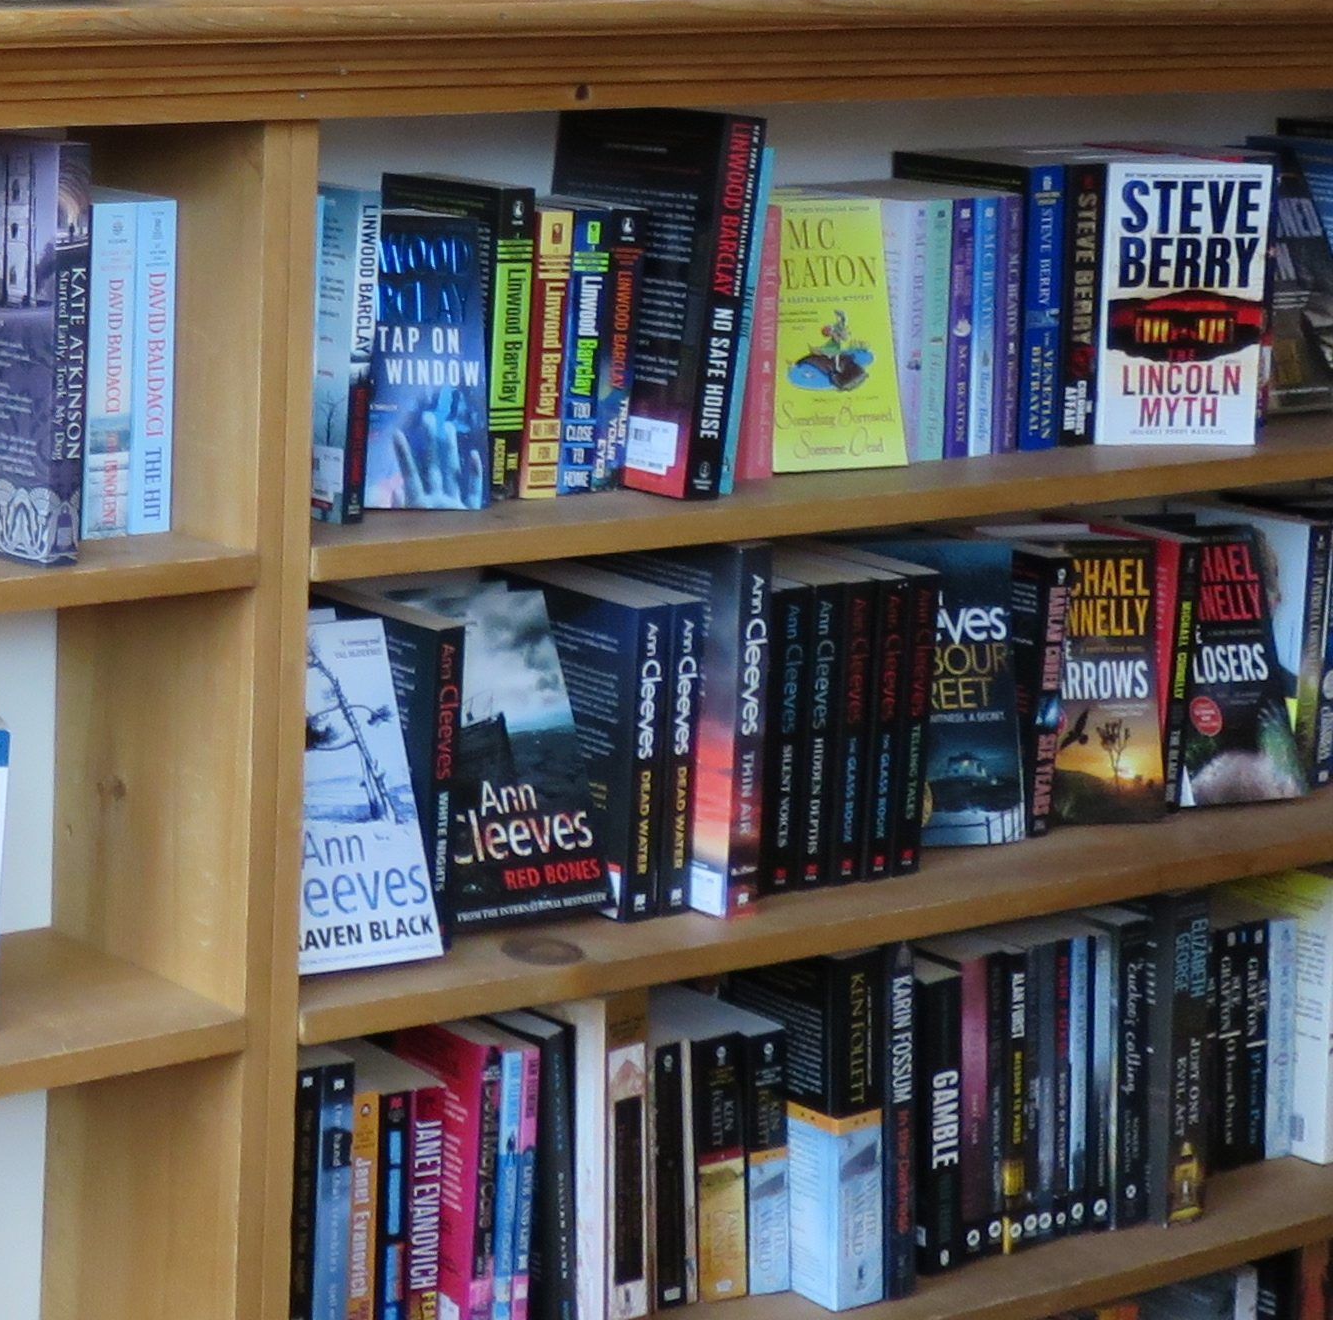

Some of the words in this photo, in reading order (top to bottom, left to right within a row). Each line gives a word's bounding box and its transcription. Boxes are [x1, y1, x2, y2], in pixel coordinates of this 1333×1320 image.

[1121, 181, 1260, 235] STEVE
[357, 204, 377, 282] LINWOOD
[1119, 237, 1259, 288] BERRY
[148, 272, 168, 341] DAVID
[352, 286, 375, 352] BARCLAY
[714, 309, 732, 329] NO
[379, 326, 419, 352] TAP
[432, 326, 459, 351] ON
[707, 333, 729, 376] SAFE
[144, 342, 166, 438] BALDACCI
[385, 361, 479, 387] WINDOW
[1122, 365, 1242, 395] LINCOLN
[700, 379, 723, 439] HOUSE
[1139, 395, 1218, 428] MYTH
[144, 446, 162, 480] THE
[142, 486, 160, 520] HIT
[751, 574, 764, 614] Ann
[742, 617, 768, 736] Cleeves
[504, 868, 540, 890] RED
[545, 860, 600, 888] BONES
[370, 915, 433, 942] BLACK
[892, 975, 913, 1032] KARIN
[892, 1034, 912, 1104] FOSSUM
[933, 1069, 959, 1170] GAMBLE
[415, 1120, 443, 1172] JANET
[409, 1173, 440, 1290] EVANOVICH
